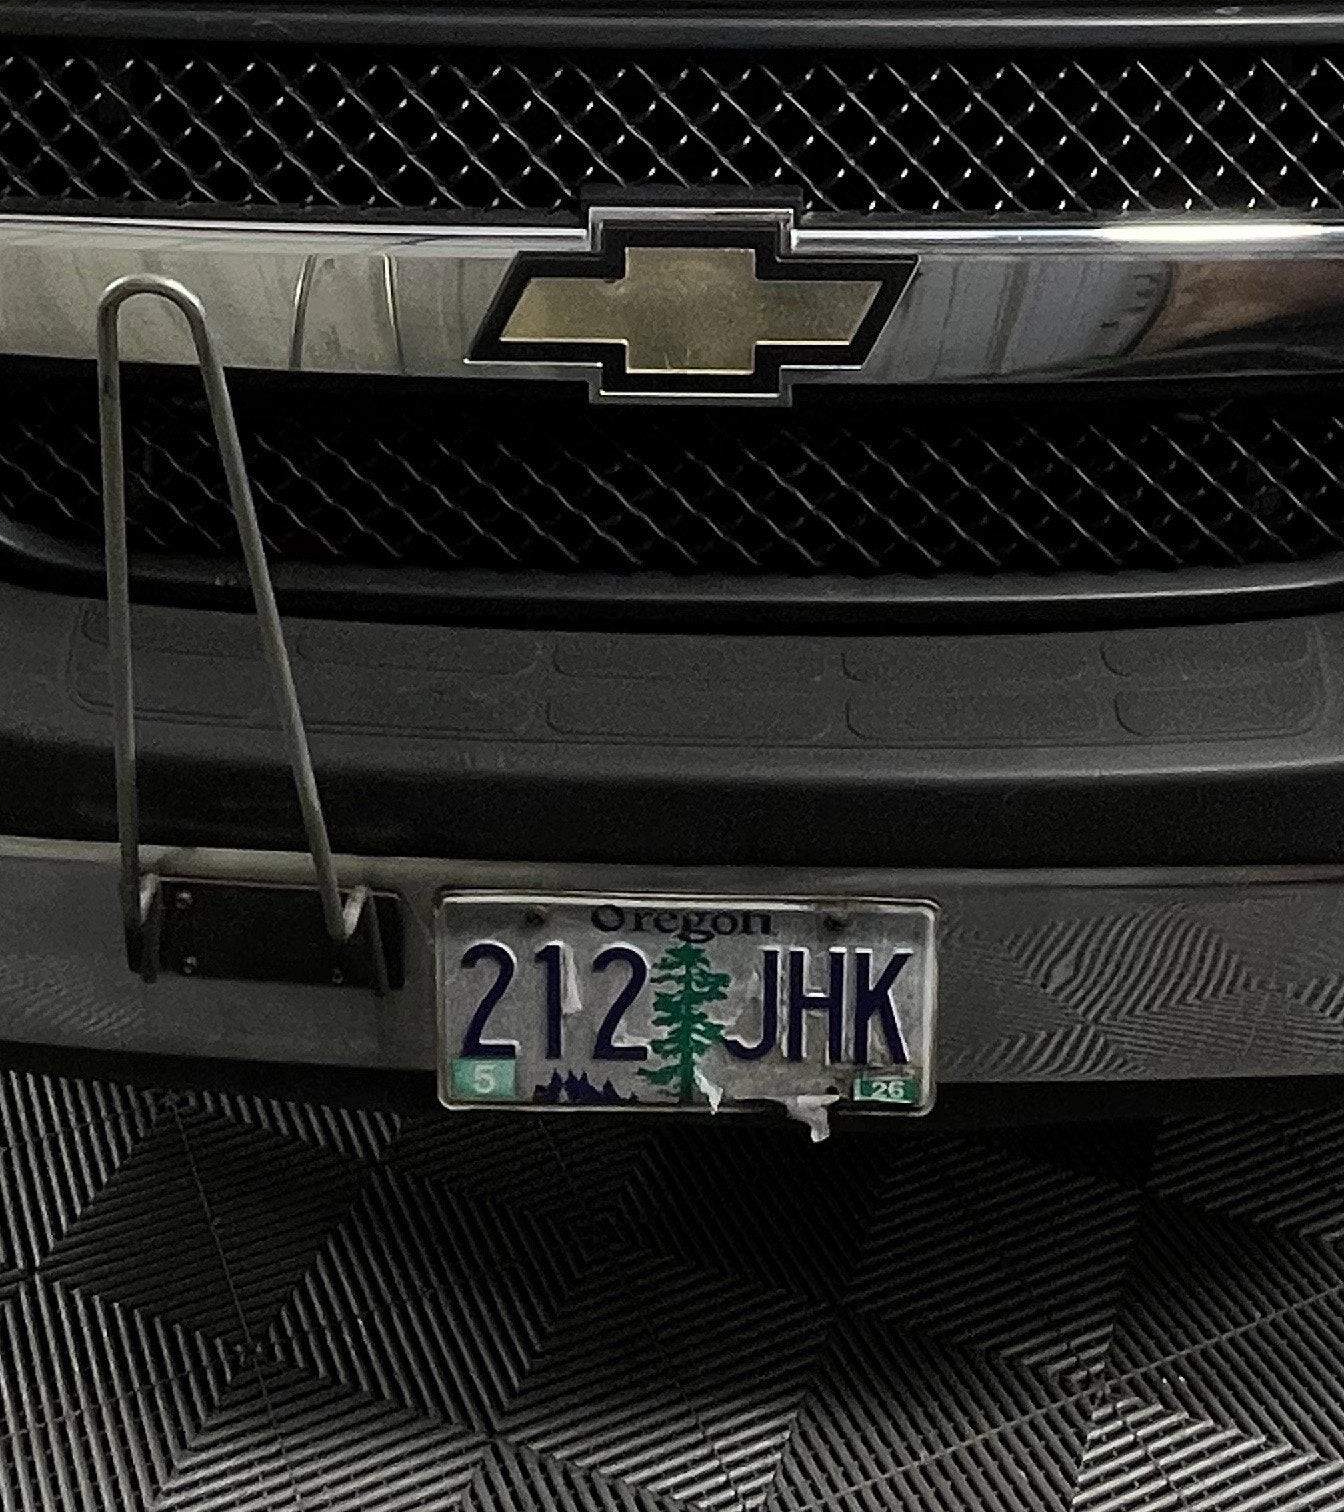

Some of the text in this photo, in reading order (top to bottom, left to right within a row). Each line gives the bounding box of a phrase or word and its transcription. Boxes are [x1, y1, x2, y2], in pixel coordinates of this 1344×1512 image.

[591, 903, 773, 944] Oregon
[460, 942, 914, 1065] 212 JHK
[473, 1066, 495, 1094] 5
[870, 1080, 906, 1099] 26
